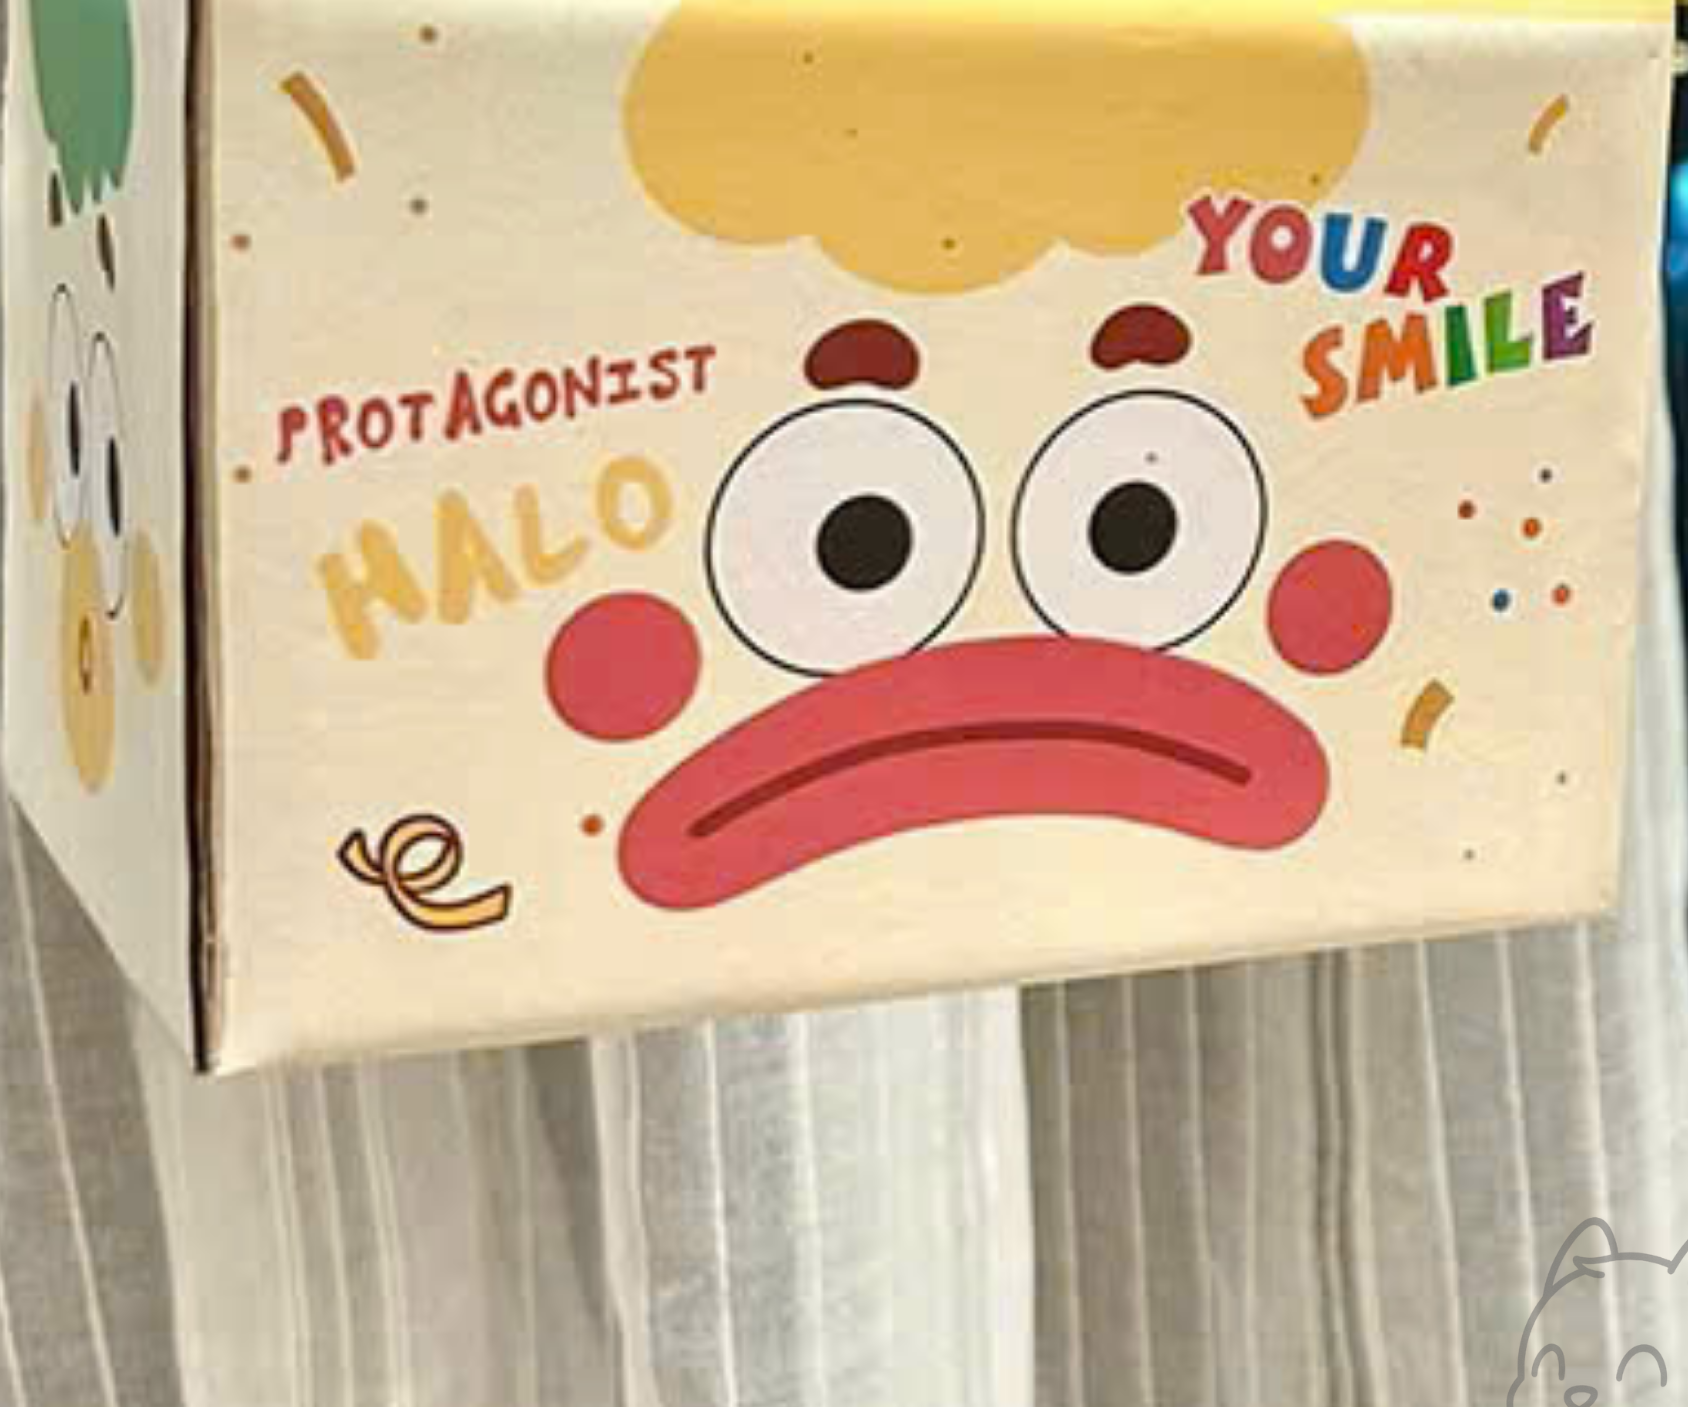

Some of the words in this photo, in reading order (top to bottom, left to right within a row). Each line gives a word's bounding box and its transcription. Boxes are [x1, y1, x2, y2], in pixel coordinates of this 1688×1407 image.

[1187, 193, 1455, 303] YOUR
[276, 344, 718, 465] PROTAGONIST
[1300, 271, 1594, 420] SMILE
[317, 454, 674, 661] HALO
